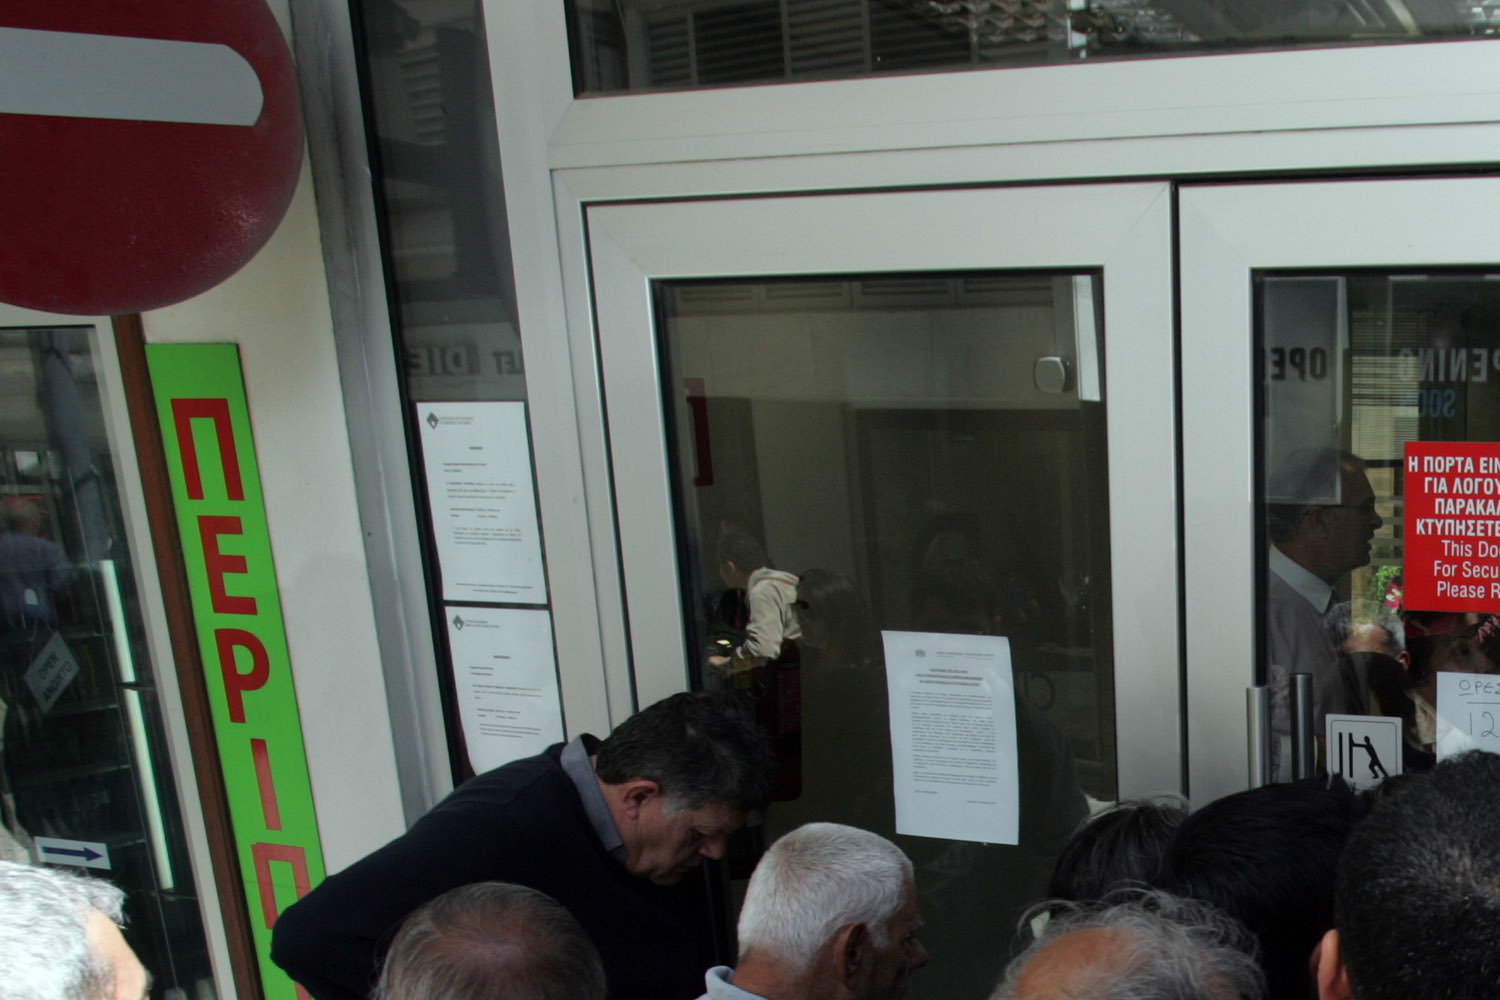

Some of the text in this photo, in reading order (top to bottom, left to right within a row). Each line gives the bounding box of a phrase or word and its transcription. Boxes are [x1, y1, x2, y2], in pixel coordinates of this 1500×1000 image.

[1409, 457, 1418, 472] Η
[1424, 457, 1474, 473] ΠΟΡΤΑ
[1424, 477, 1448, 493] ΓΙΑ
[1442, 540, 1472, 557] This
[1434, 561, 1457, 577] For
[1437, 582, 1485, 598] Please
[39, 651, 59, 680] OPEN
